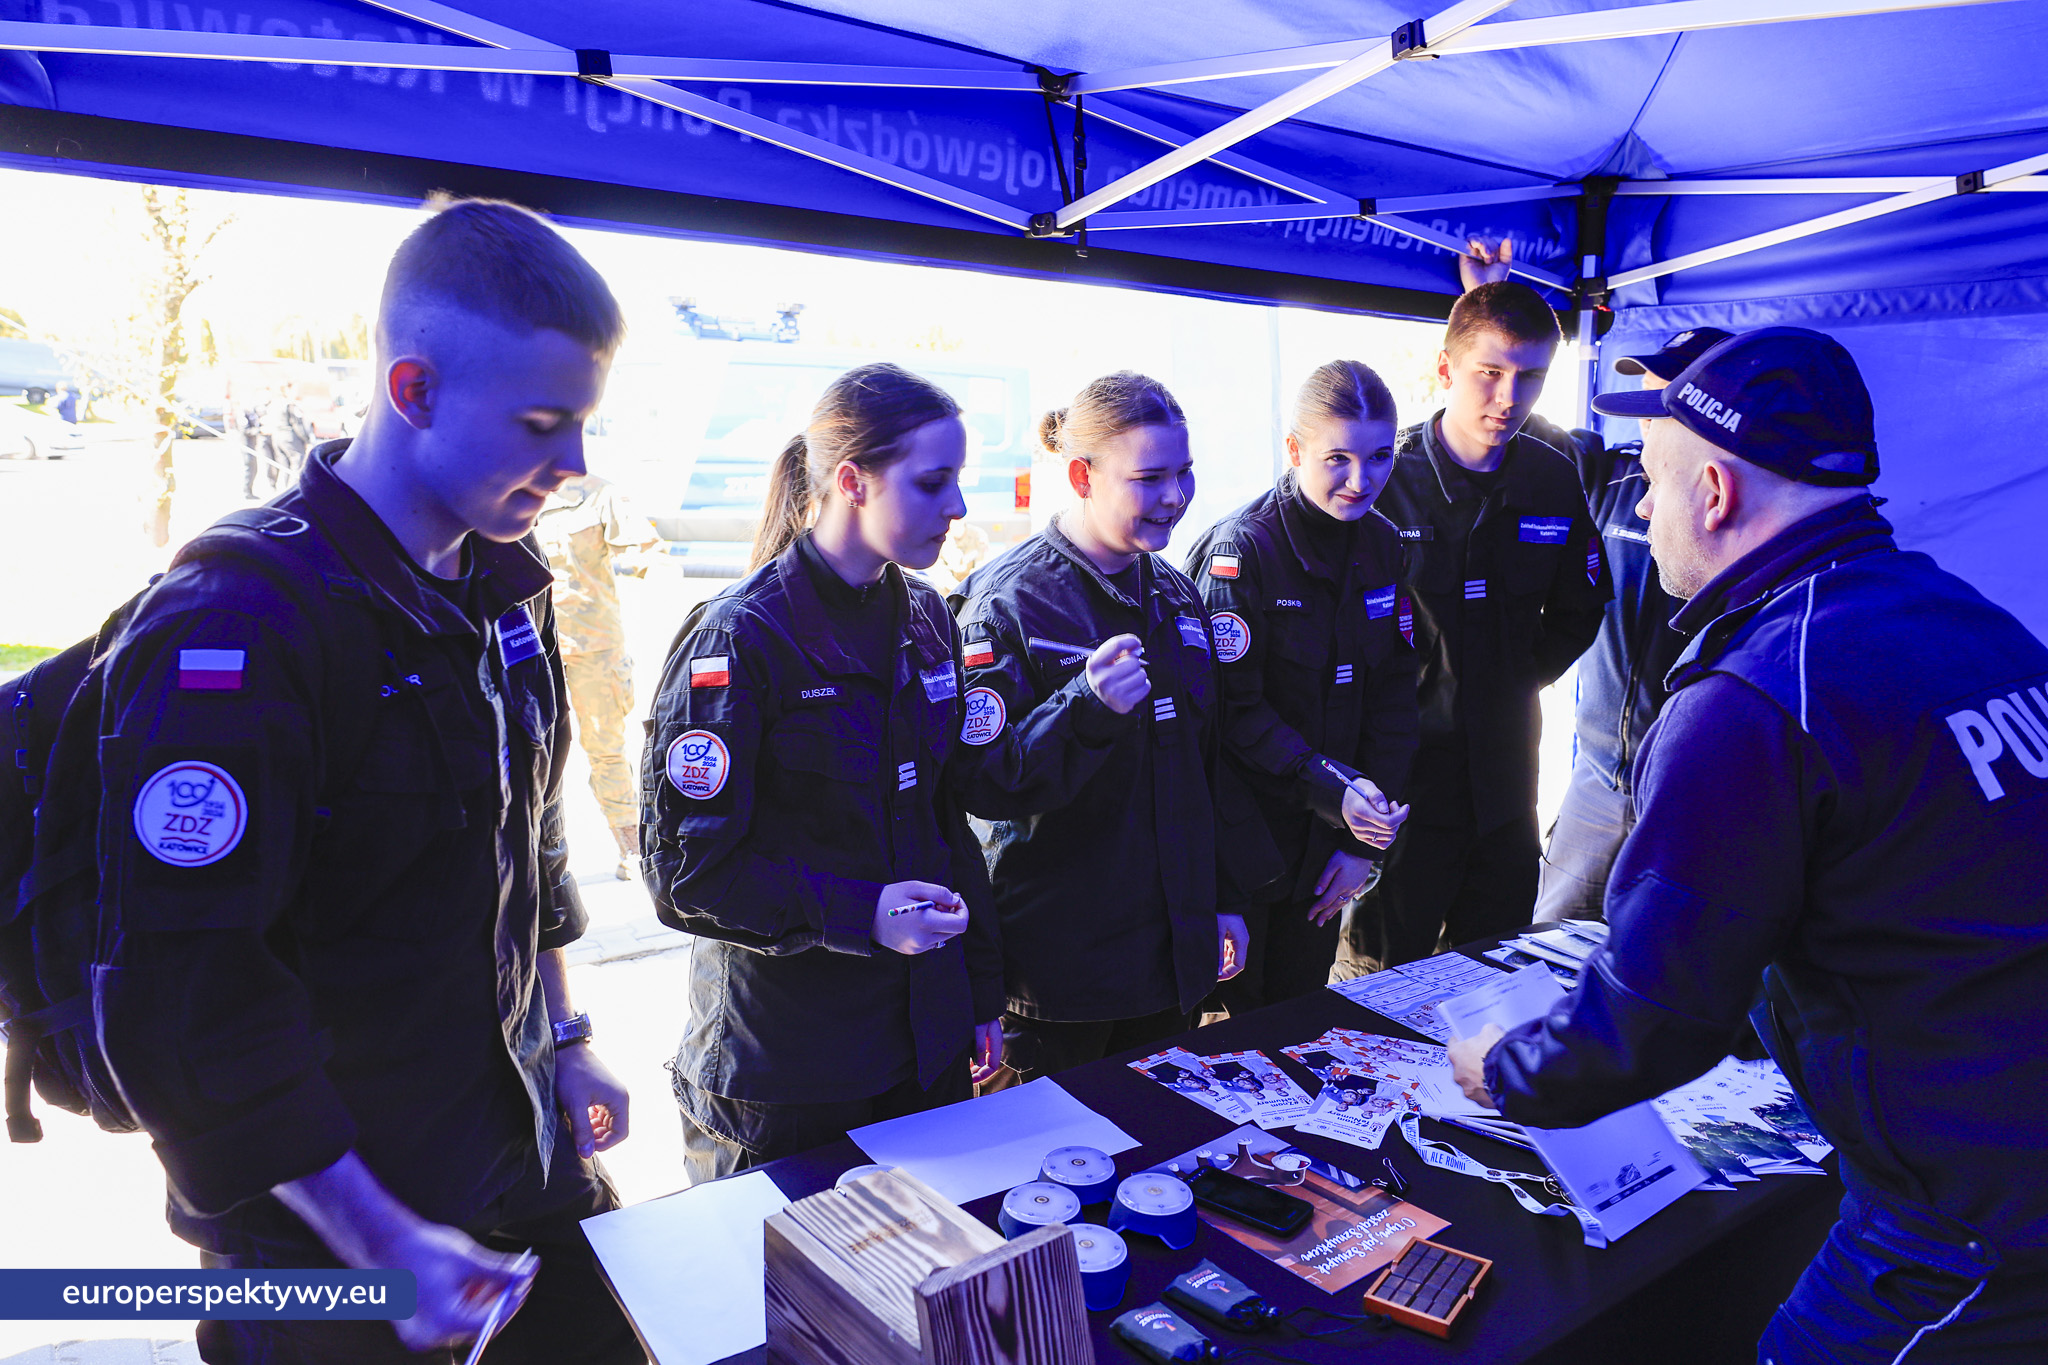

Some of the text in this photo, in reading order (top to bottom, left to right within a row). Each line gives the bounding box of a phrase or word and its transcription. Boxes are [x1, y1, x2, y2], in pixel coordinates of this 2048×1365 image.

[1677, 382, 1742, 433] POLICJA
[801, 686, 837, 699] DUSZEK
[966, 716, 991, 730] ZDZ
[966, 731, 991, 739] KATOWICE
[1945, 682, 2048, 801] POL
[682, 765, 710, 779] ZDZ
[682, 783, 710, 792] KATOWICE
[163, 813, 214, 836] ZDZ
[1430, 1151, 1443, 1164] ALE
[1313, 1246, 1366, 1275] Sznupek
